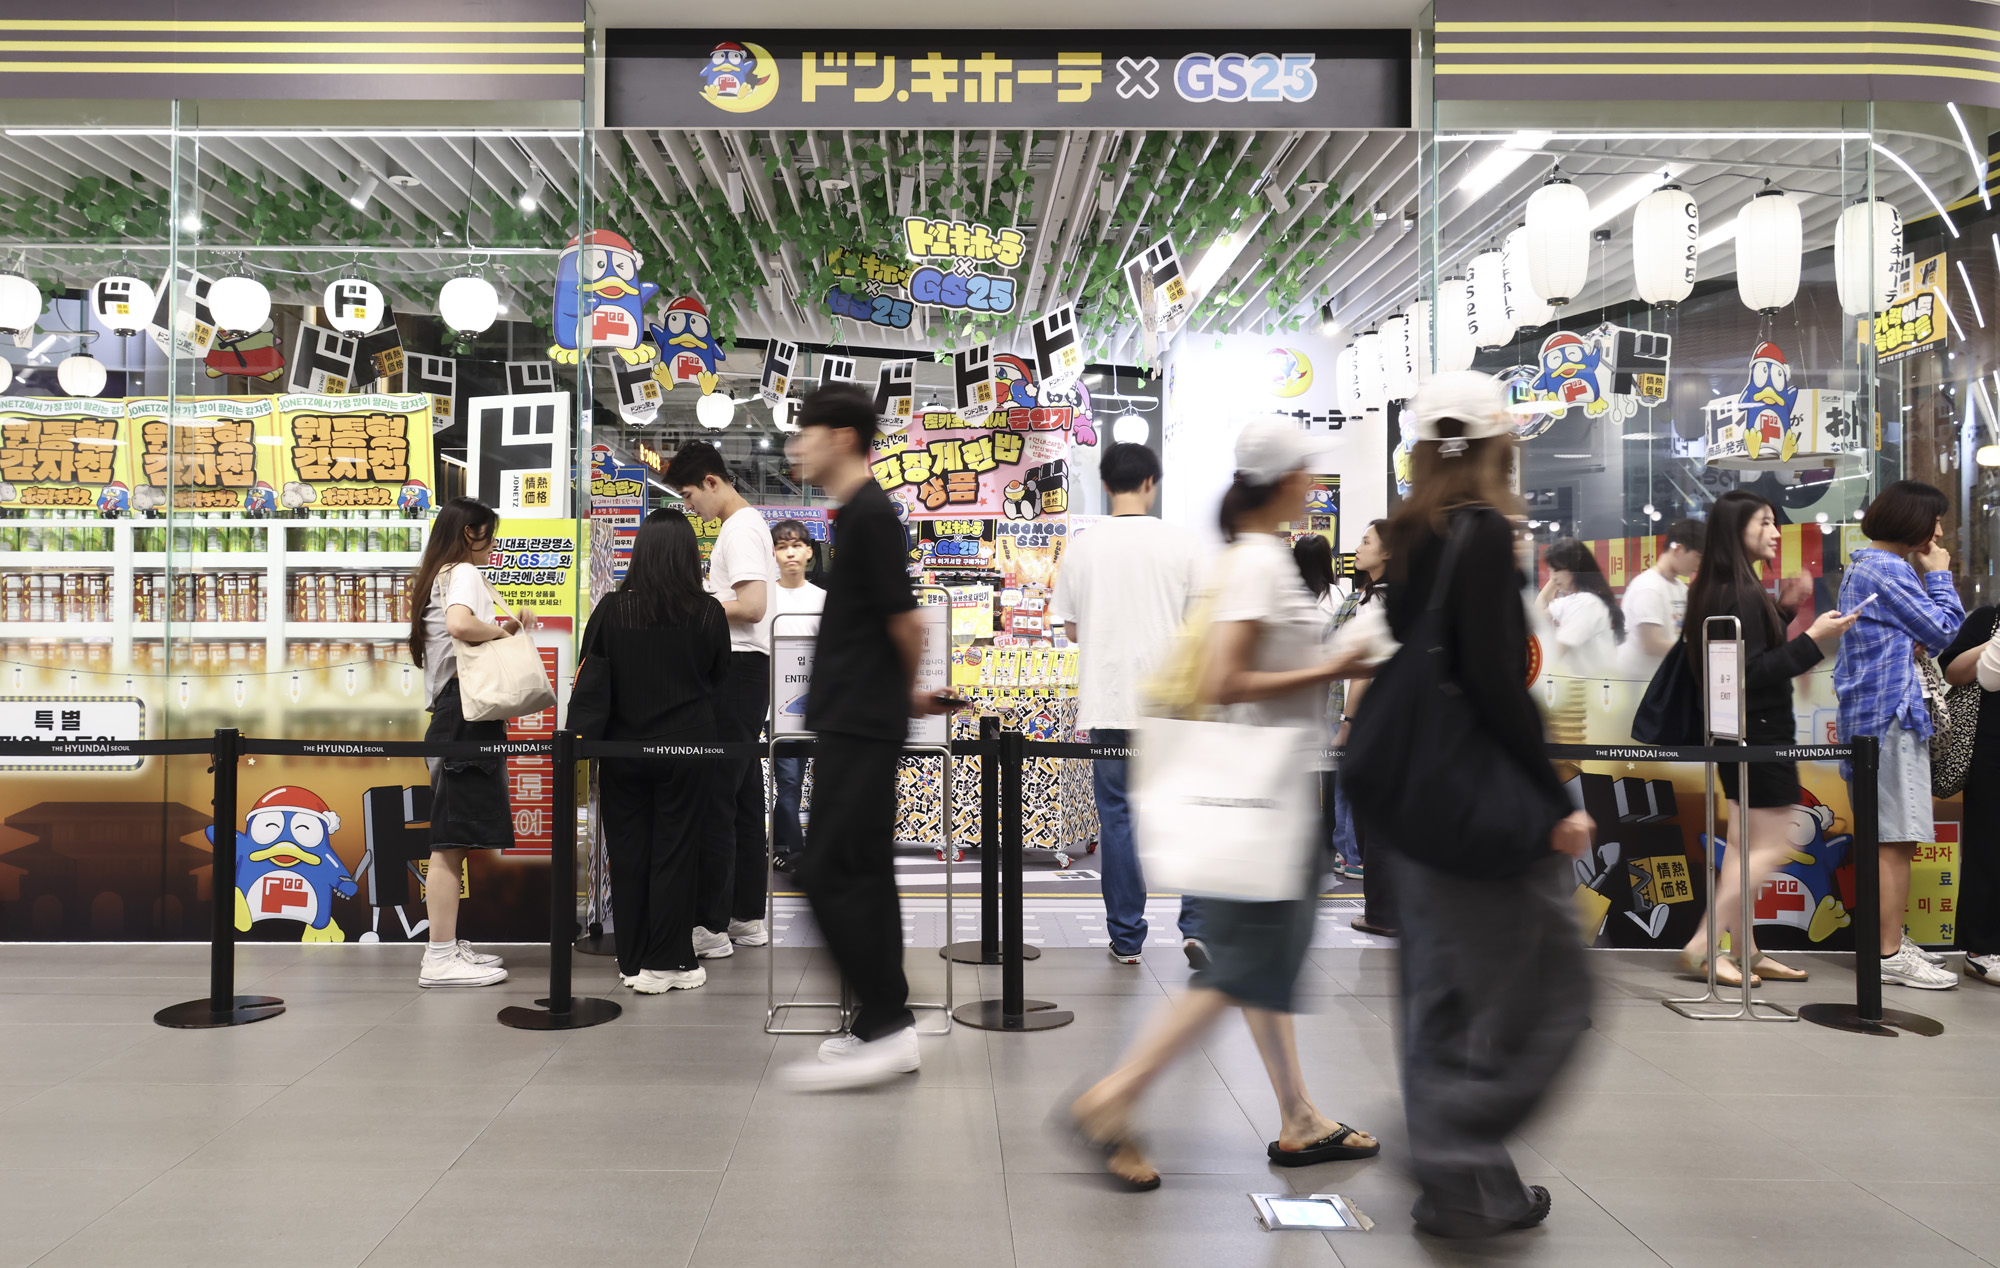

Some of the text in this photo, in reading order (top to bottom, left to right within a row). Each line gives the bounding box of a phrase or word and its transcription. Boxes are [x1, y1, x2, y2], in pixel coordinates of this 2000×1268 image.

[801, 51, 1103, 103] ドン.キホーテ
[1174, 53, 1318, 102] GS25
[1684, 202, 1697, 284] GS25
[911, 267, 1015, 312] GS25
[1466, 268, 1479, 335] GS25
[1033, 307, 1075, 381] ド
[762, 338, 795, 388] ド
[955, 344, 989, 409] ド
[1646, 376, 1664, 386] 情熱
[875, 361, 913, 415] ド
[1645, 386, 1664, 396] 価格
[64, 401, 82, 411] 많이
[84, 402, 109, 414] 팔리는
[200, 403, 216, 413] 많이
[218, 403, 243, 416] 팔리는
[246, 401, 273, 416] 감자칩
[280, 396, 428, 411] JONETZ에서 가장 많이 팔리는 감자칩
[292, 446, 409, 483] 감자칩
[479, 405, 555, 509] ド
[870, 430, 1024, 491] 간장계란밥
[0, 450, 115, 484] 감자칩
[143, 452, 257, 488] 감자칩
[525, 476, 548, 489] 情熱
[525, 491, 548, 504] 価格
[919, 472, 980, 510] 상품
[997, 523, 1067, 535] MOOMOO
[505, 538, 574, 549] 대표 관광명소
[937, 540, 979, 555] GS25
[1017, 535, 1050, 546] SSI
[518, 553, 572, 567] GS25와
[500, 571, 532, 582] 한국에
[1720, 692, 1731, 700] EXIT
[64, 744, 110, 753] HYUNDAI
[316, 744, 363, 754] HYUNDAI
[493, 743, 540, 753] HYUNDAI
[656, 746, 703, 755] HYUNDAI
[1610, 748, 1657, 758] HYUNDAI
[1789, 748, 1834, 757] HYUNDAI
[1656, 862, 1686, 880] 情熱
[1660, 880, 1688, 898] 価格
